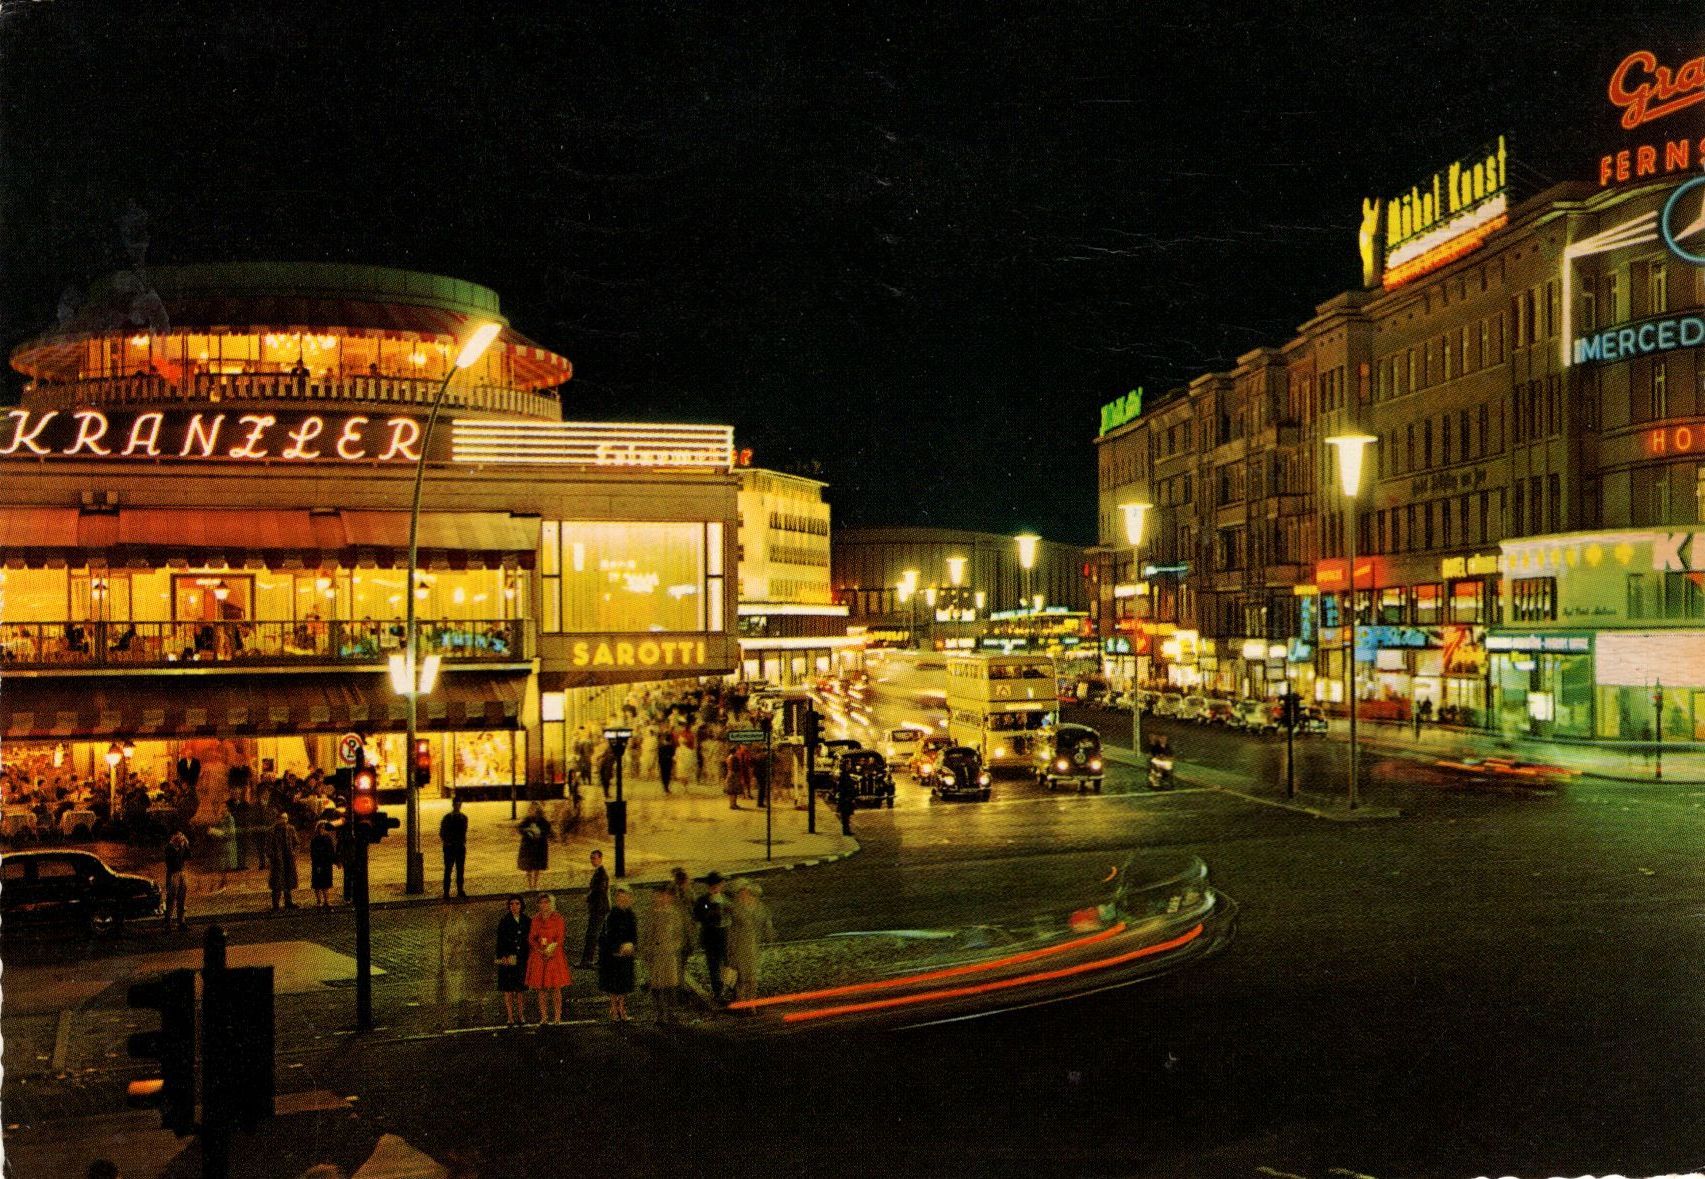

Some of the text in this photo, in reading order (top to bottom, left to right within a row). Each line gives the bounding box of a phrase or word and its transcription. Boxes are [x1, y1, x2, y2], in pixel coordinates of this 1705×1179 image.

[1448, 135, 1506, 213] Kunst
[1575, 317, 1705, 363] MERCED
[0, 409, 422, 460] KRANZLER
[1652, 426, 1692, 451] HO
[573, 640, 705, 666] SAROTTI
